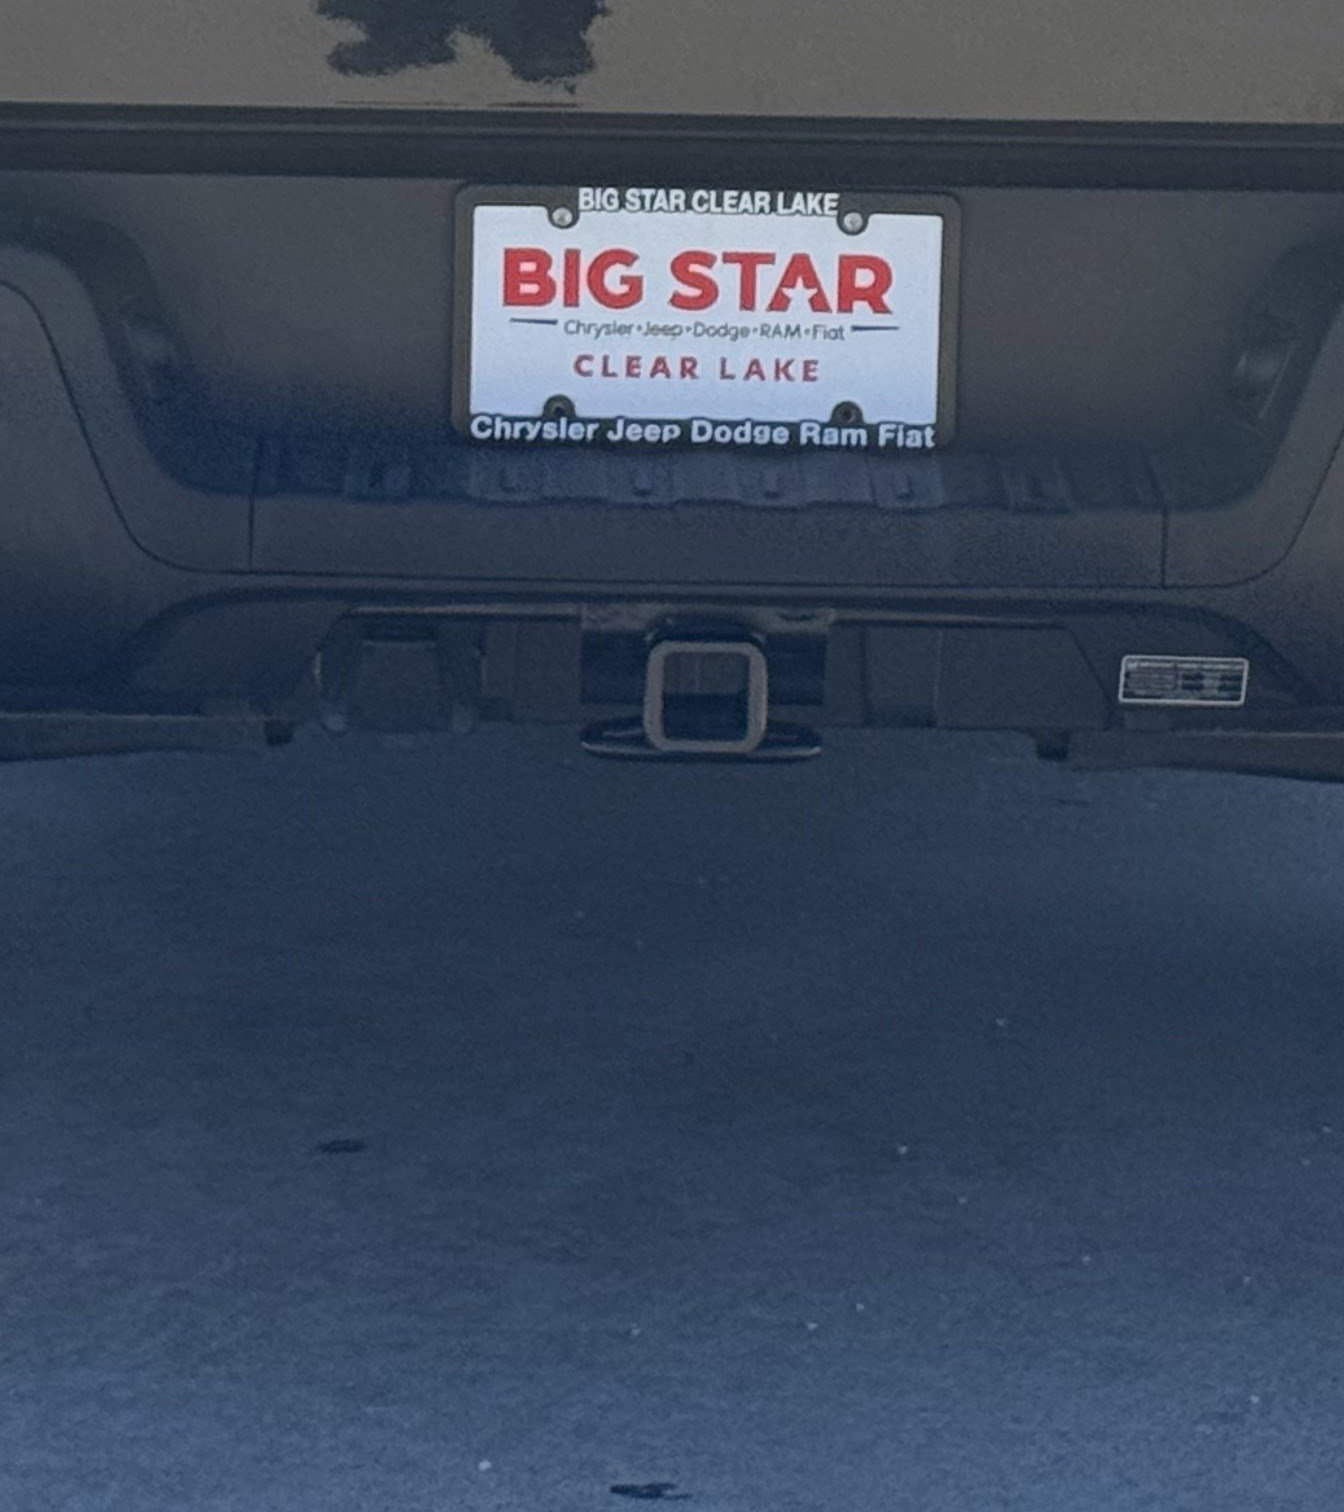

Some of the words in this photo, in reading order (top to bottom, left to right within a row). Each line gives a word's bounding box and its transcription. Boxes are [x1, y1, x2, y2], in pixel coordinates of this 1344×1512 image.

[578, 187, 619, 211] BIG
[624, 188, 685, 213] STAR
[691, 190, 770, 214] CLEAR
[777, 192, 840, 216] LAKE
[503, 247, 644, 309] BIG
[668, 249, 893, 314] STAR
[574, 354, 699, 379] CLEAR
[720, 356, 820, 382] LAKE
[470, 414, 599, 441] Chrysler
[607, 417, 681, 443] Jeep
[691, 420, 790, 445] Dodge
[799, 421, 868, 447] Ram
[877, 423, 936, 449] Fiat
